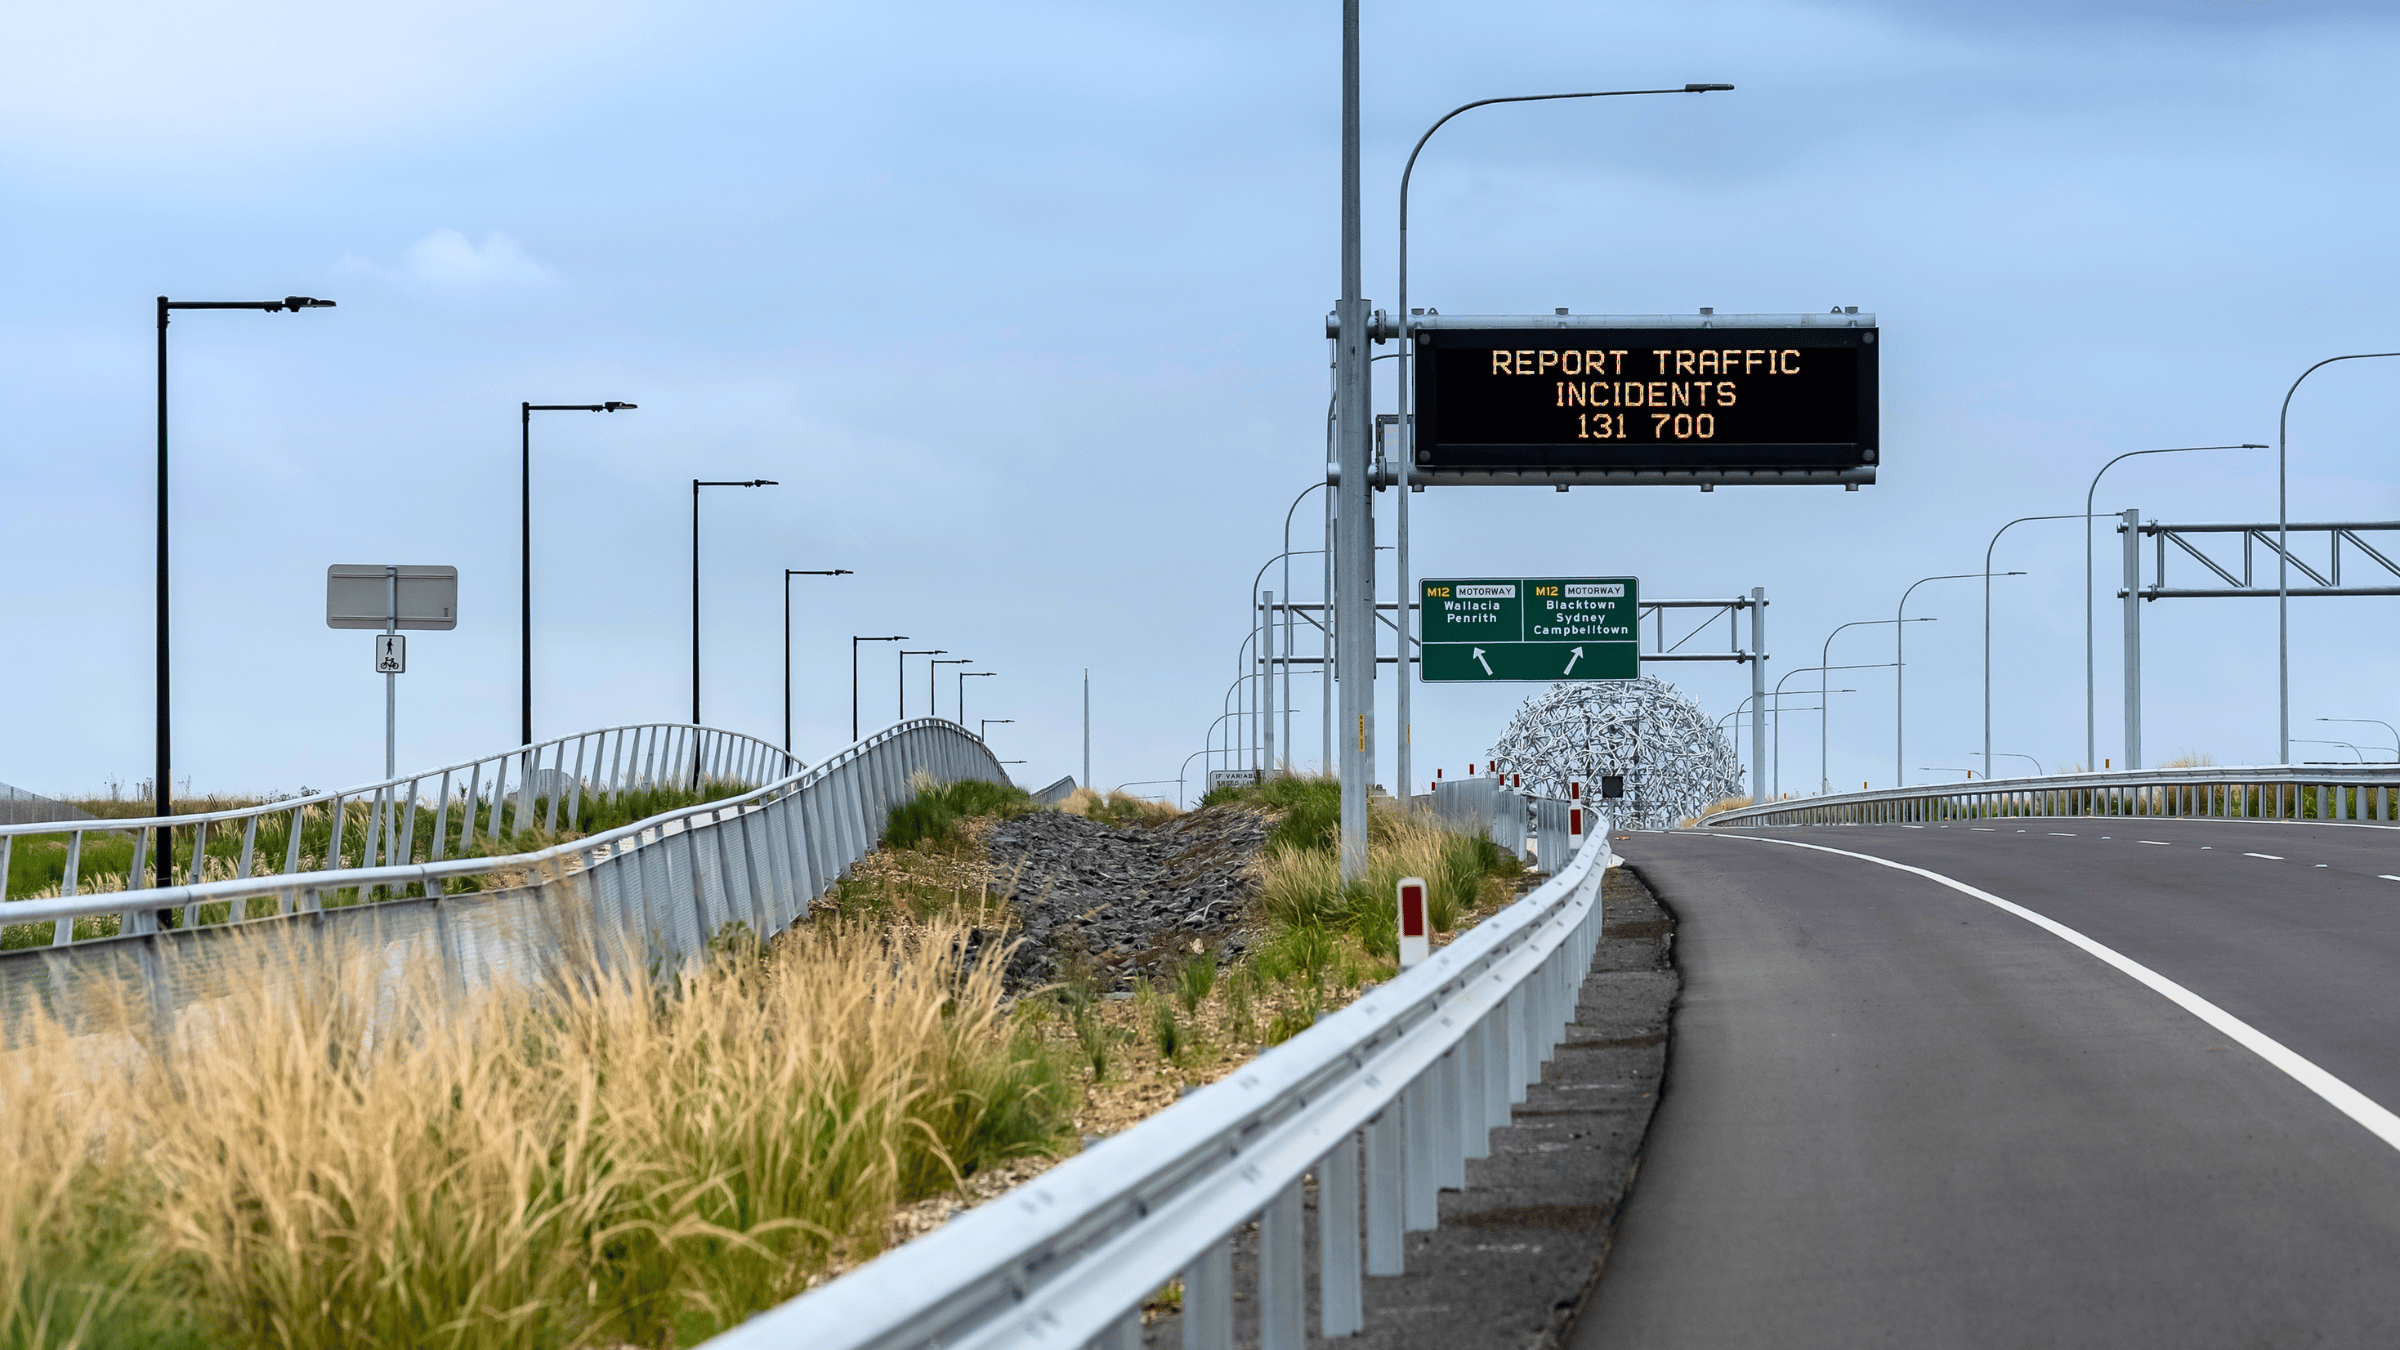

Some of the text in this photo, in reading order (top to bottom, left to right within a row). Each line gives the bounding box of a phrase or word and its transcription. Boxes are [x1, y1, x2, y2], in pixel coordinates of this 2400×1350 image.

[1492, 349, 1801, 375] REPORT TRAFFIC
[1556, 381, 1737, 407] INCIDENTS
[1578, 413, 1715, 439] 131 700
[1426, 587, 1512, 598] M12 MOTORWAY
[1535, 586, 1621, 597] M12 MOTORWAY
[1444, 600, 1500, 611] Wallacia
[1546, 600, 1616, 610] Blacktown
[1447, 613, 1497, 623] Penrith
[1556, 612, 1606, 625] Sydney
[1533, 625, 1629, 637] Campbelltown
